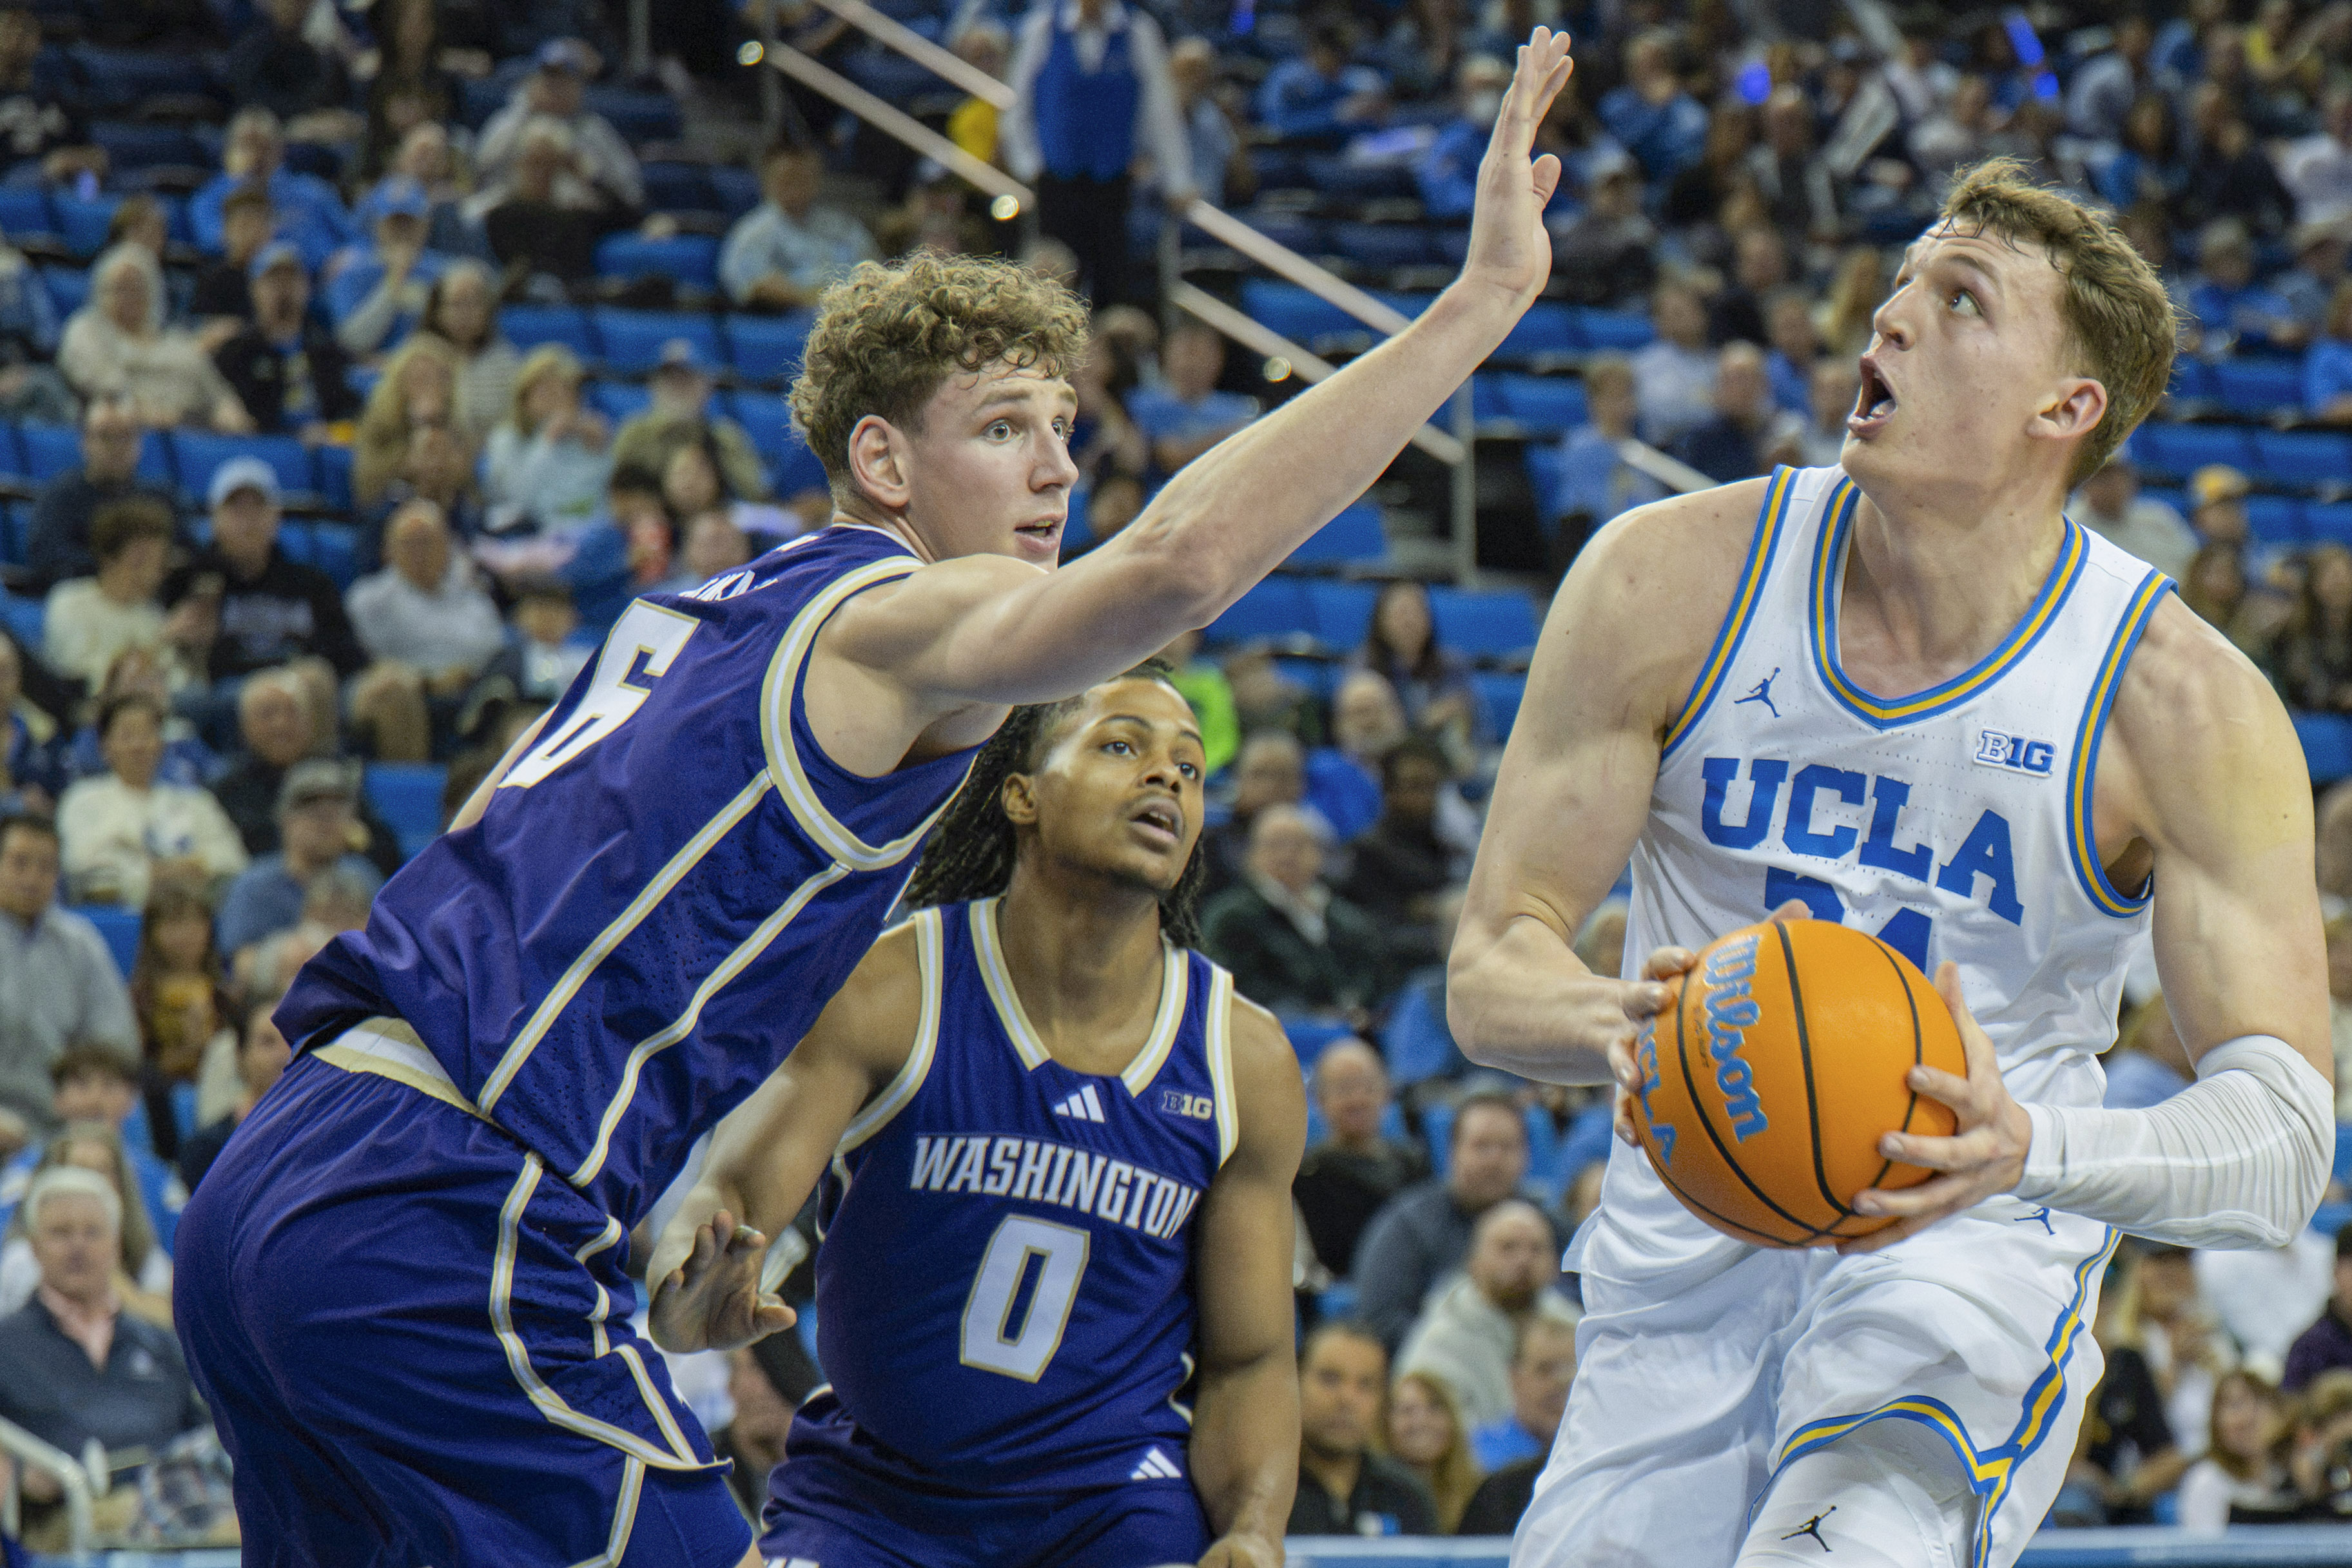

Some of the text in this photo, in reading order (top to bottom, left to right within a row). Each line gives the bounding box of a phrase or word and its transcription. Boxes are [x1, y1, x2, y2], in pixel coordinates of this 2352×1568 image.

[497, 597, 701, 788] 6
[1701, 757, 2024, 926] UCLA
[1703, 933, 1769, 1145] Wilson
[909, 1136, 1200, 1240] WASHINGTON
[960, 1214, 1091, 1384] 0
